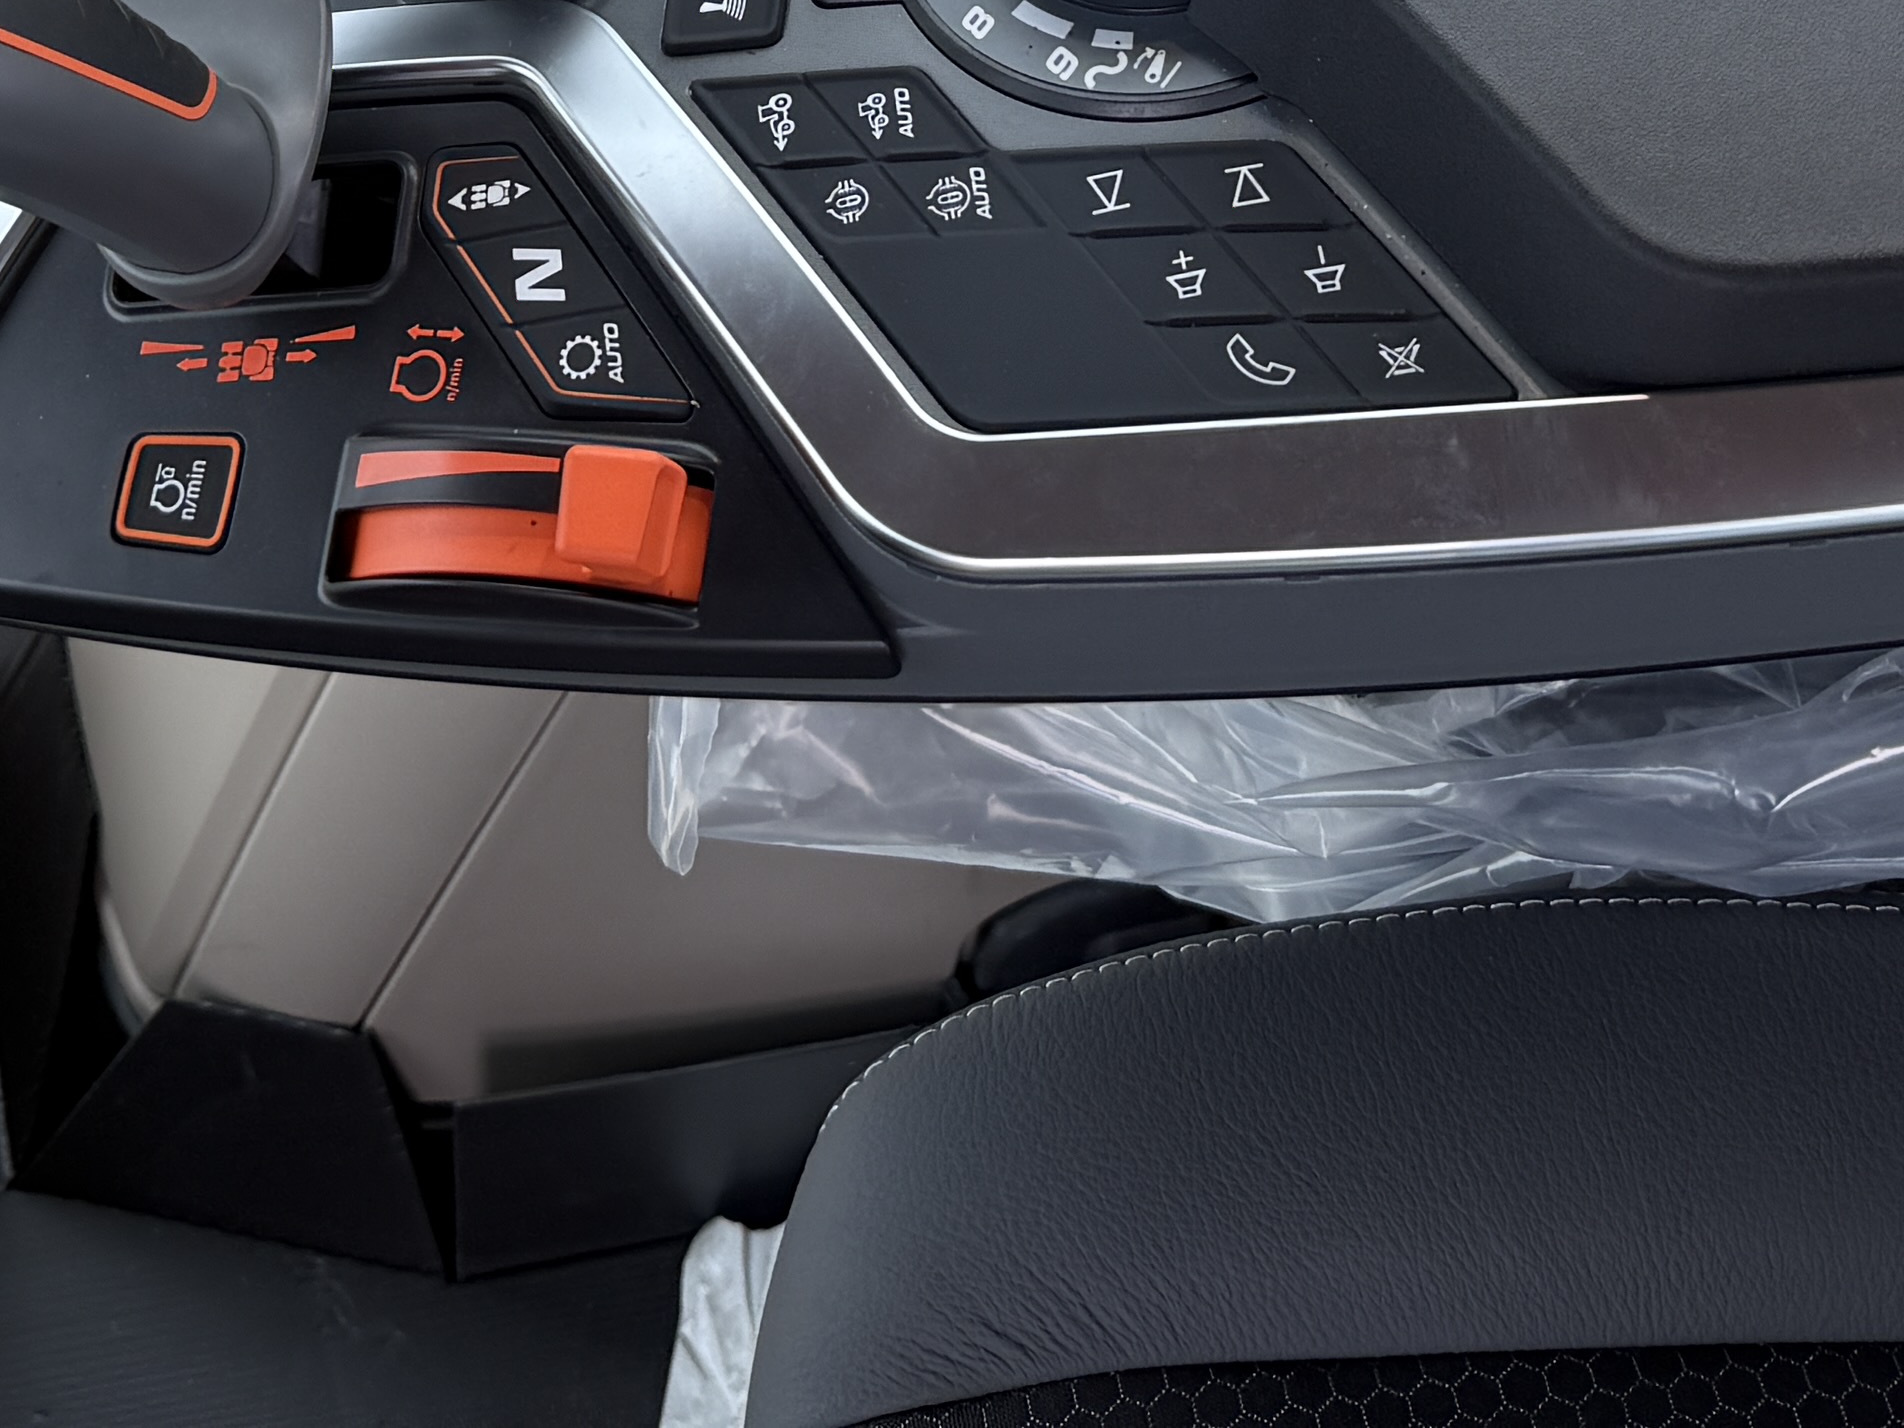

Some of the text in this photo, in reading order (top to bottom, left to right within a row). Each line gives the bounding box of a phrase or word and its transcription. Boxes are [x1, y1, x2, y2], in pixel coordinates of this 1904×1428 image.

[961, 5, 995, 40] 8
[1045, 46, 1079, 81] 9
[894, 88, 914, 138] AUTO
[969, 167, 993, 219] AUTO
[512, 248, 566, 301] N
[603, 322, 625, 384] AUTO
[446, 357, 464, 403] n/min
[181, 460, 207, 520] n/min
